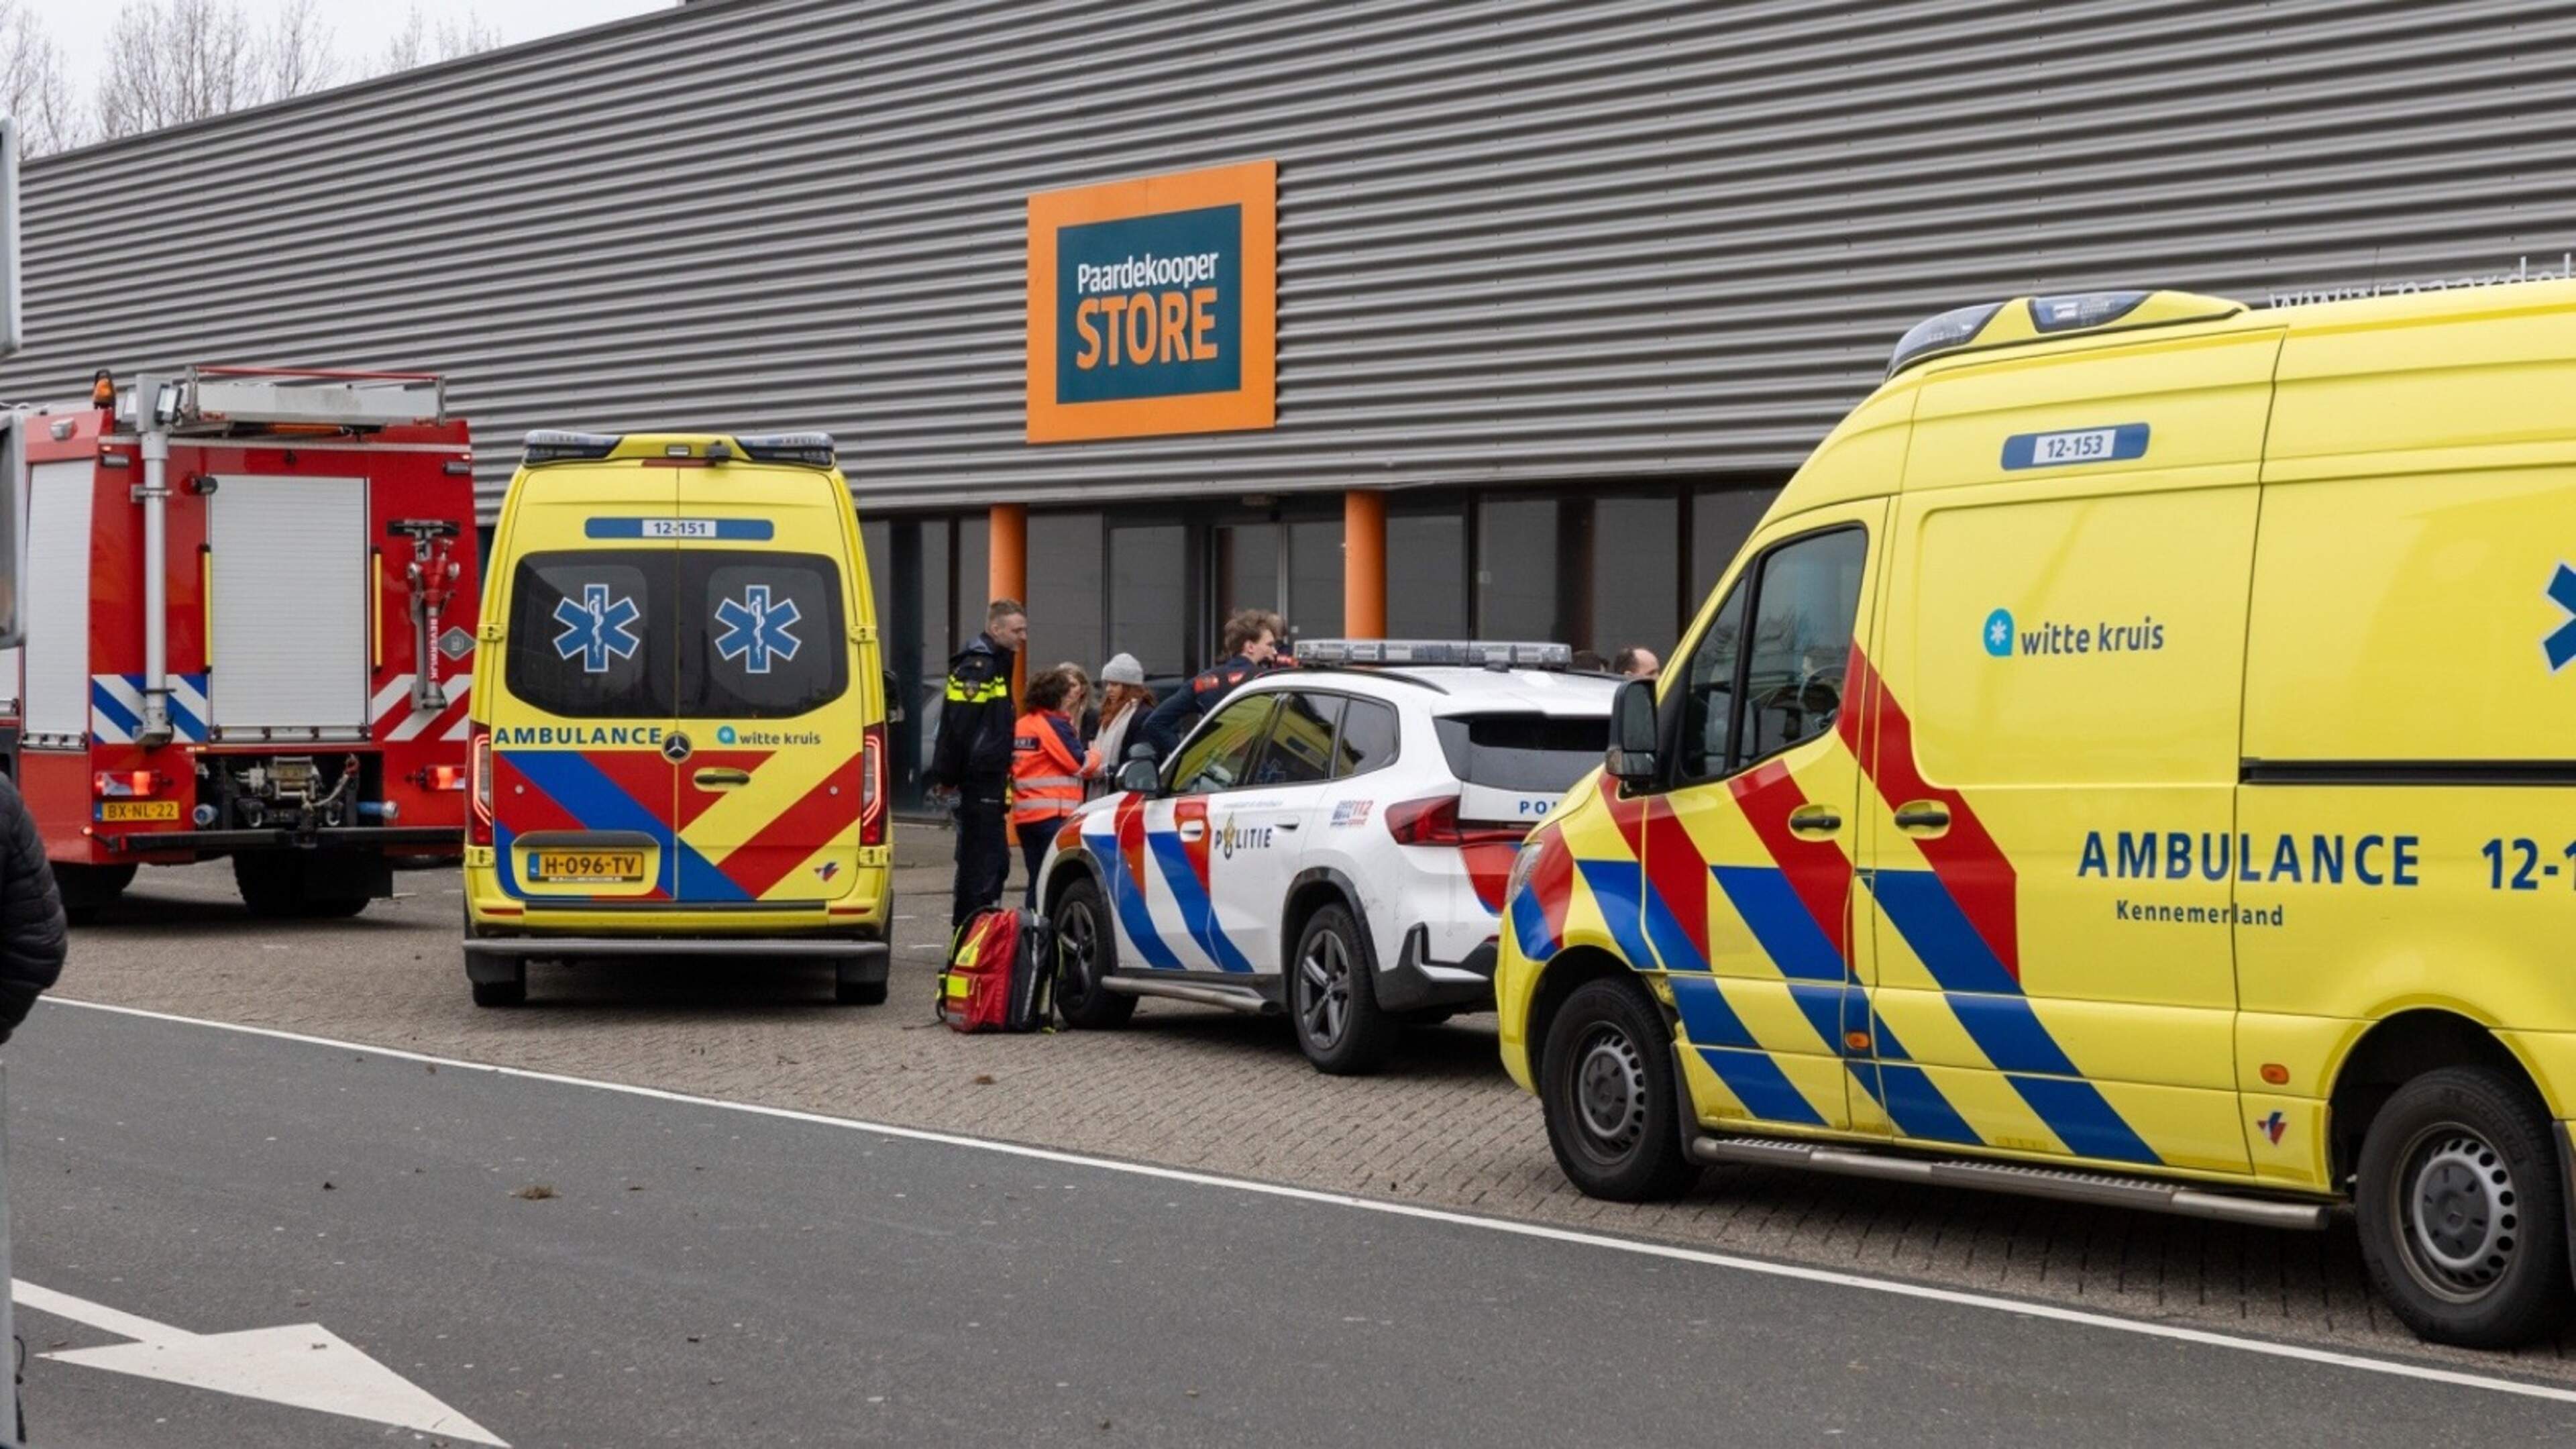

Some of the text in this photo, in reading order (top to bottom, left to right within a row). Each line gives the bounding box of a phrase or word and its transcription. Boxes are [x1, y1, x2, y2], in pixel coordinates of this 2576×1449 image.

[1077, 252, 1219, 294] Paardekooper
[1076, 286, 1218, 370] STORE
[2047, 435, 2104, 458] 12-153
[654, 523, 706, 534] 12-151
[2021, 615, 2164, 655] witte kruis
[494, 727, 663, 745] AMBULANCE
[739, 731, 821, 745] witte kruis
[545, 857, 635, 874] H-096-TV
[2076, 831, 2419, 885] AMBULANCE
[2116, 900, 2284, 926] Kennemerland
